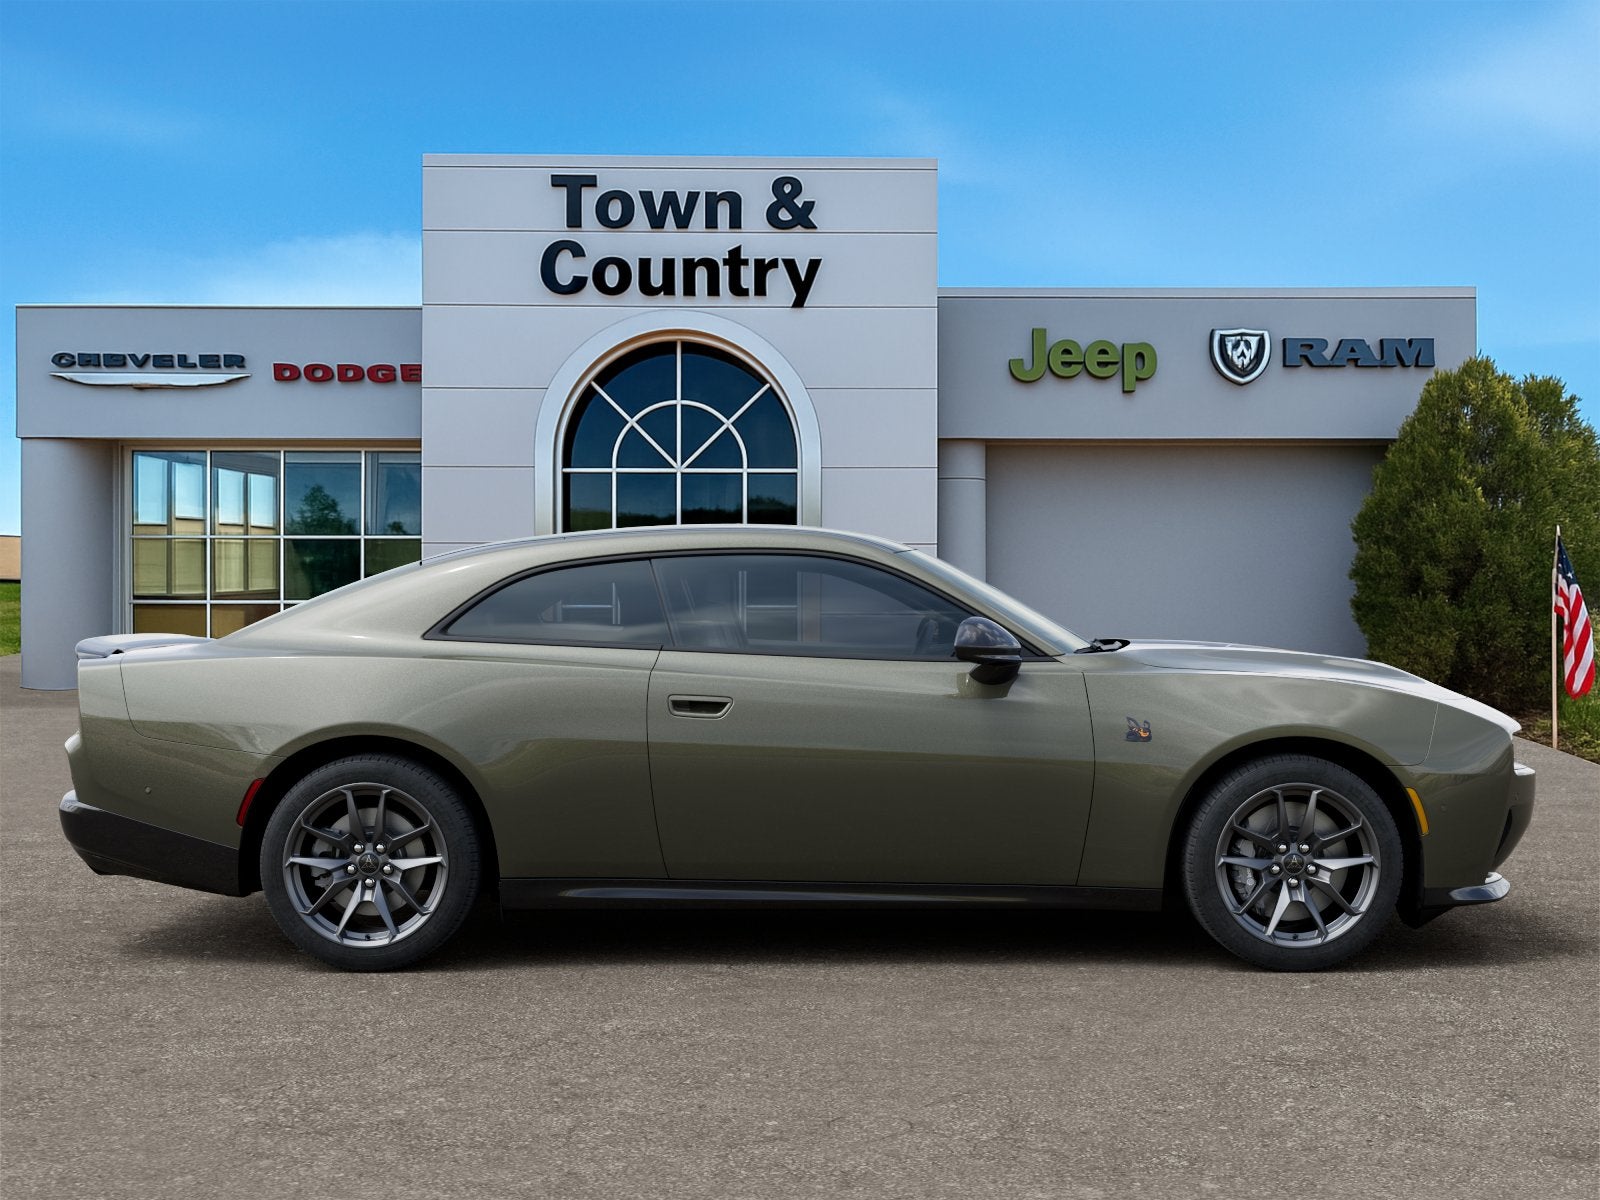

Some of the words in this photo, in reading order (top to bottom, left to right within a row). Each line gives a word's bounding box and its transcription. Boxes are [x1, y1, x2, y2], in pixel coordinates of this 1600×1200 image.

[550, 174, 743, 229] Town
[766, 175, 818, 230] &
[540, 239, 823, 308] Country
[273, 363, 422, 383] DODGE
[1008, 328, 1158, 393] Jeep
[1282, 337, 1436, 368] RAM
